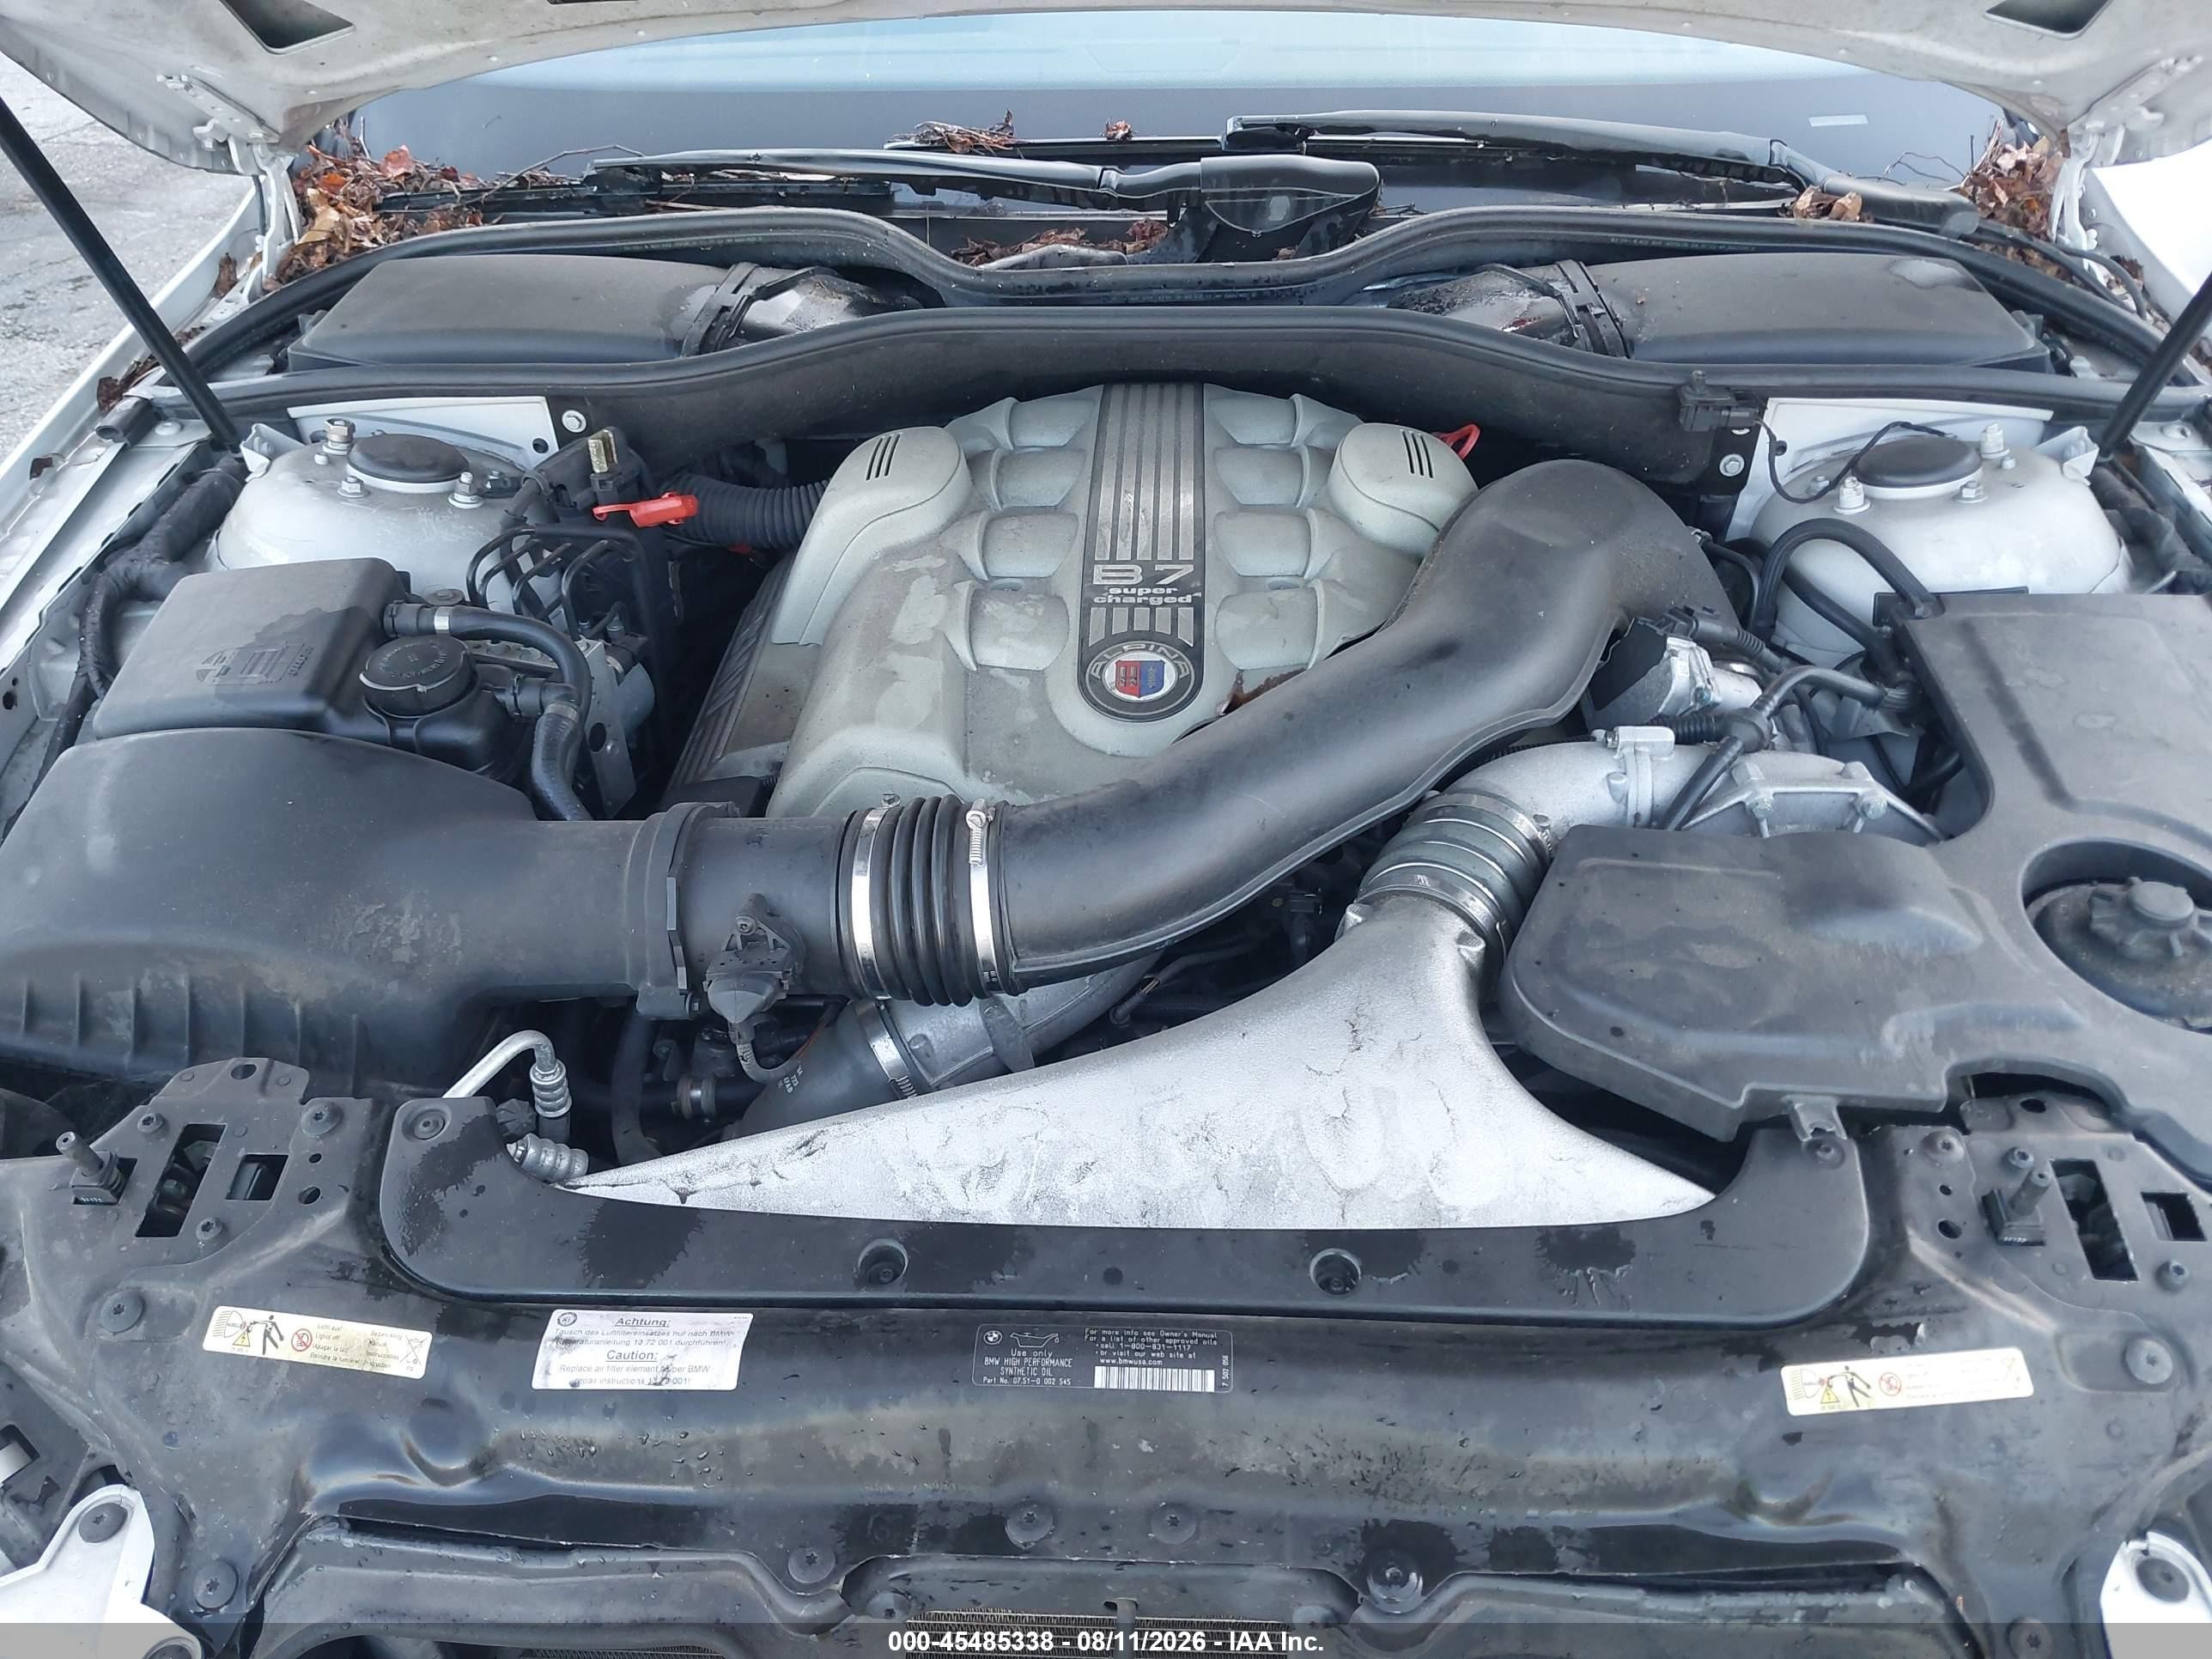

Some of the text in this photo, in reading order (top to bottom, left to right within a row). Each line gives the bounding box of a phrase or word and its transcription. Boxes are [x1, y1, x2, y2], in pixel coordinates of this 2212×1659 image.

[1108, 587, 1178, 596] super
[1093, 594, 1192, 605] charged
[1091, 643, 1190, 679] ALPINA
[614, 1316, 671, 1328] Achtung:
[1159, 1329, 1188, 1338] Owner's
[1119, 1342, 1191, 1351] 1-800-831-1117
[1164, 1337, 1199, 1346] approved
[605, 1350, 659, 1362] Caution:
[1011, 1347, 1053, 1358] Use only
[984, 1356, 1073, 1368] BMW HIGH PERFORMANCE
[1099, 1357, 1164, 1366] www.bmwusa.com
[560, 1364, 591, 1374] Replace
[688, 1364, 711, 1373] BMW
[1000, 1366, 1054, 1376] SYNTHETIC OIL
